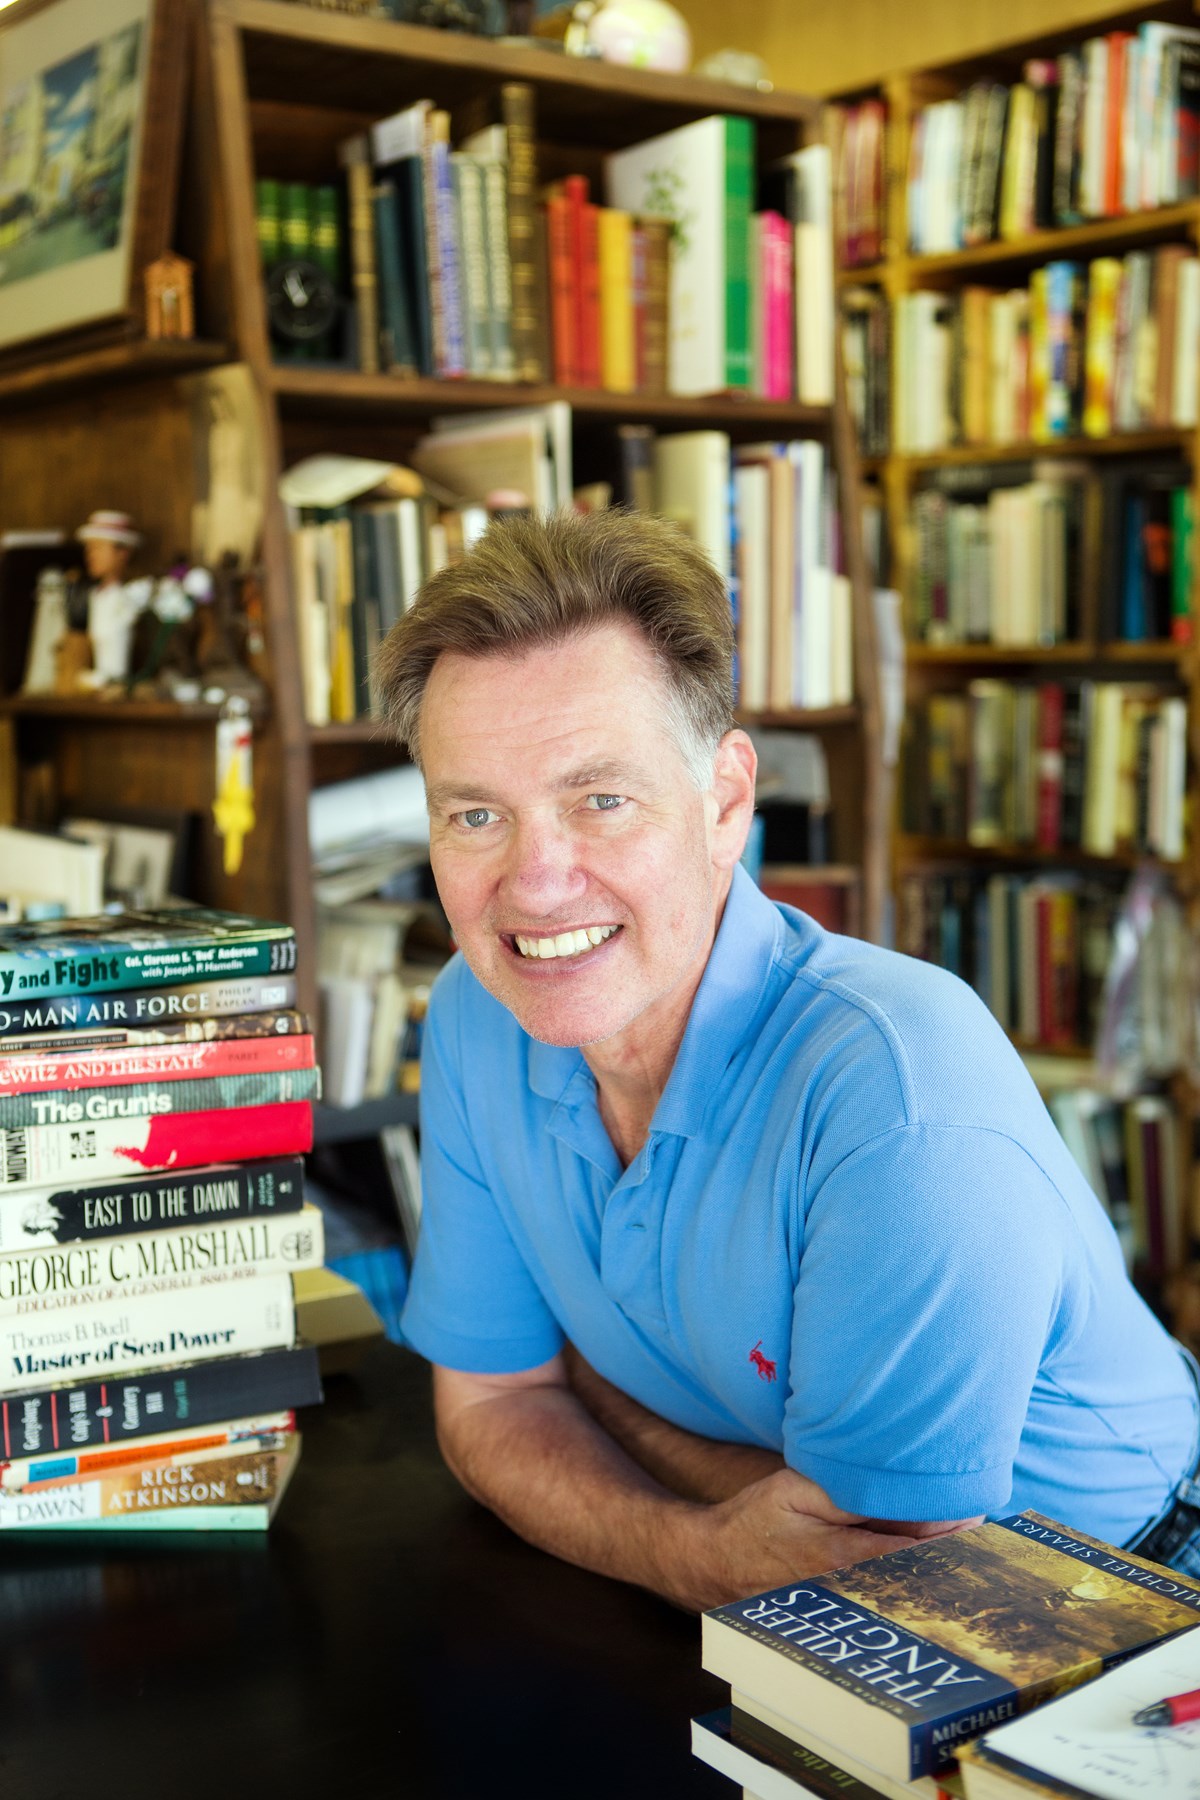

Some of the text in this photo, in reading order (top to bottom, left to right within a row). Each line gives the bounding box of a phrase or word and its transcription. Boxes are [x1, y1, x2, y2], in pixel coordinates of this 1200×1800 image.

[19, 970, 50, 989] and
[54, 956, 120, 987] Fight
[125, 956, 142, 968] Col.
[143, 952, 180, 966] Clarence
[218, 946, 259, 960] Anderson
[141, 966, 163, 978] with
[164, 963, 195, 978] Joseph
[205, 960, 244, 972] Hamelin
[86, 1000, 128, 1022] AIR
[136, 992, 210, 1017] FORCE
[215, 999, 256, 1009] KAPLAN
[218, 986, 252, 997] PHILIP
[64, 1062, 105, 1079] AND
[110, 1058, 144, 1076] THE
[145, 1055, 203, 1073] STATE
[31, 1093, 173, 1125] The Grunts
[6, 1128, 27, 1183] MIDWAY
[84, 1180, 240, 1229] EAST TO THE DAWN
[0, 1248, 100, 1299] GEORGE
[110, 1243, 130, 1282] C.
[138, 1225, 276, 1278] MARSHALL
[16, 1291, 95, 1314] EDUCATION
[98, 1288, 115, 1301] OF
[130, 1277, 193, 1297] GENERAL
[8, 1330, 71, 1350] Thomas
[92, 1316, 130, 1338] Buell
[12, 1328, 236, 1377] Master of Sea Power
[69, 1390, 88, 1413] Hill
[122, 1386, 141, 1430] Cemetery
[145, 1391, 164, 1414] Hill
[21, 1398, 43, 1451] Gettysburg
[141, 1465, 195, 1487] RICK
[17, 1498, 84, 1521] DAWN
[109, 1481, 226, 1510] ATKINSON
[1012, 1519, 1200, 1607] MICHAEL SHAARA
[742, 1599, 938, 1708] THE KILLER
[770, 1589, 987, 1687] ANGELS
[715, 1613, 904, 1715] WINNER OF THE PULITZER PRIZE
[932, 1702, 1016, 1745] MICHAEL
[792, 1748, 858, 1788] In the
